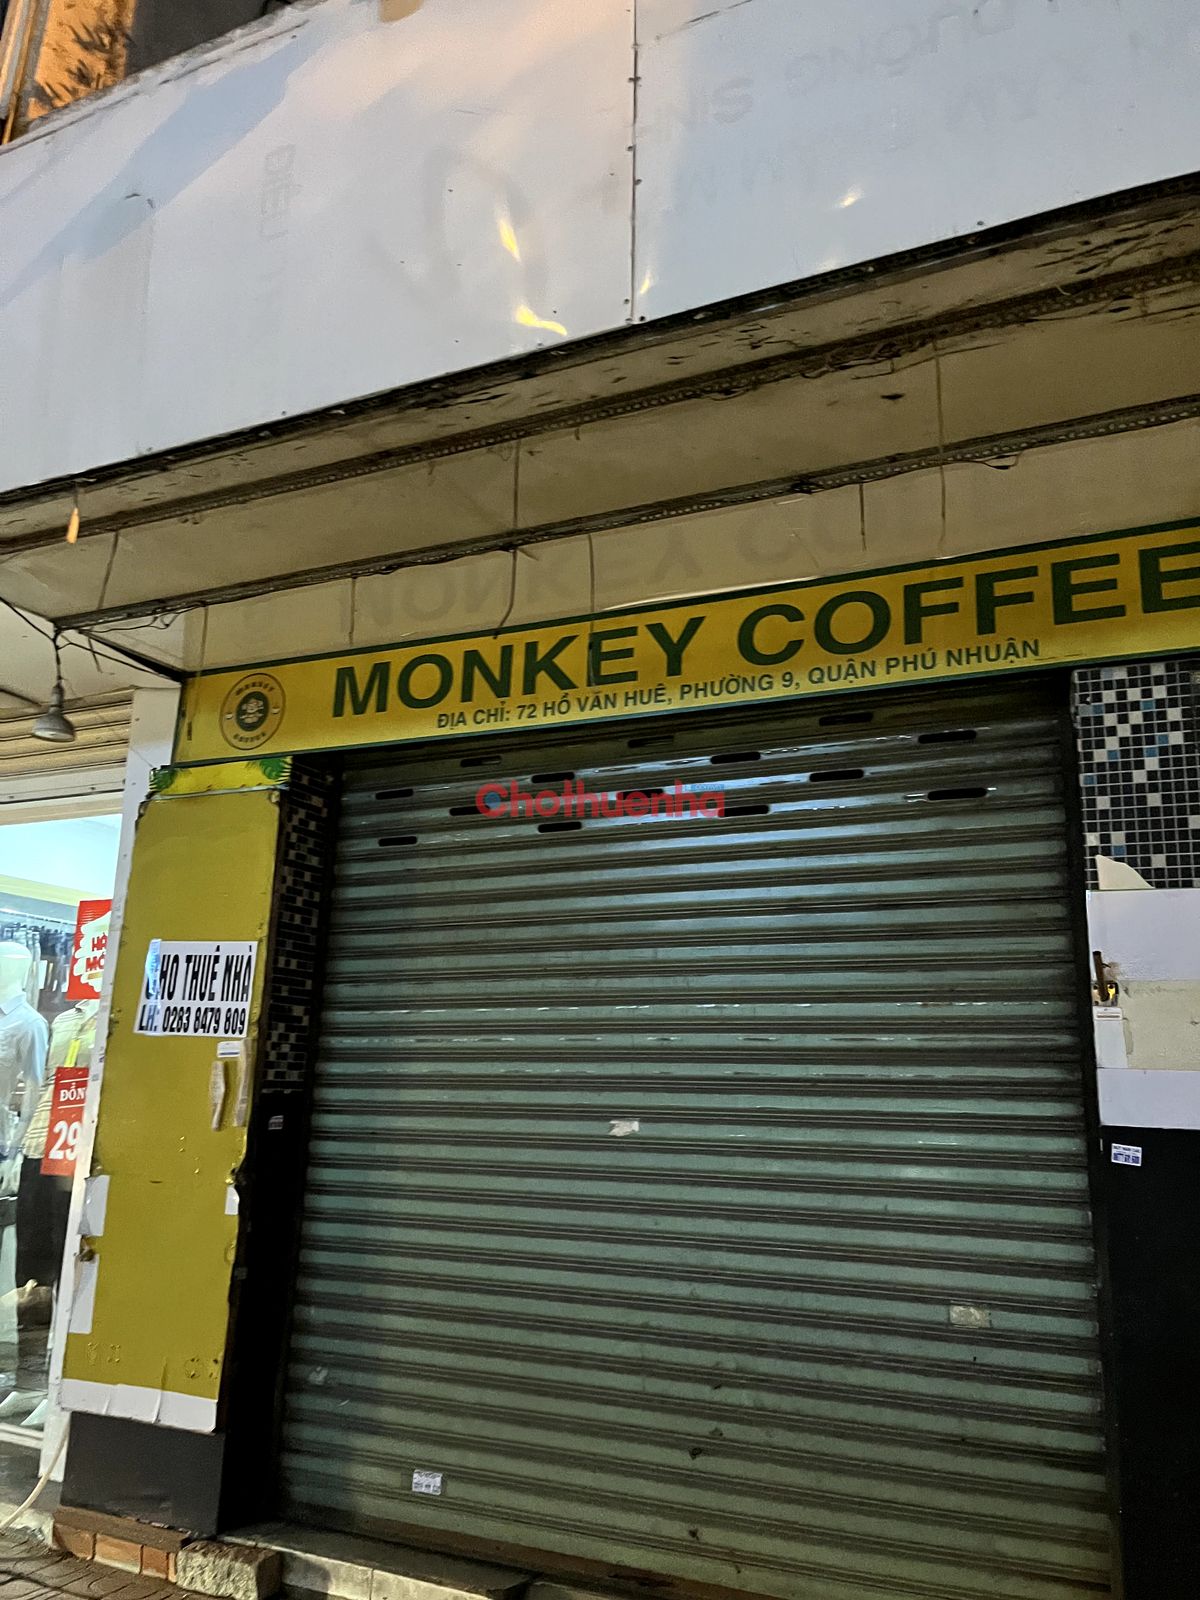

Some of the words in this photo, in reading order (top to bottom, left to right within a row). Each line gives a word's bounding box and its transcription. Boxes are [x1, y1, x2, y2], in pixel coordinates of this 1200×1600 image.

[332, 615, 706, 718] MONKEY
[737, 541, 1200, 666] COFFEE
[437, 711, 467, 730] ĐỊA
[472, 701, 510, 725] CHỈ:
[516, 704, 537, 720] 72
[576, 691, 616, 713] VĂN
[624, 684, 672, 707] HUÊ,
[680, 672, 773, 700] PHƯỜNG
[781, 671, 800, 691] 9,
[808, 658, 876, 684] QUẬN
[885, 648, 937, 674] PHÚ
[946, 638, 1039, 667] NHUẬN
[182, 945, 221, 1001] THUÊ
[221, 945, 252, 1002] NHÀ
[138, 1004, 160, 1032] LH:
[162, 1006, 192, 1033] 0283
[193, 1007, 221, 1034] 8479
[224, 1007, 246, 1035] 809
